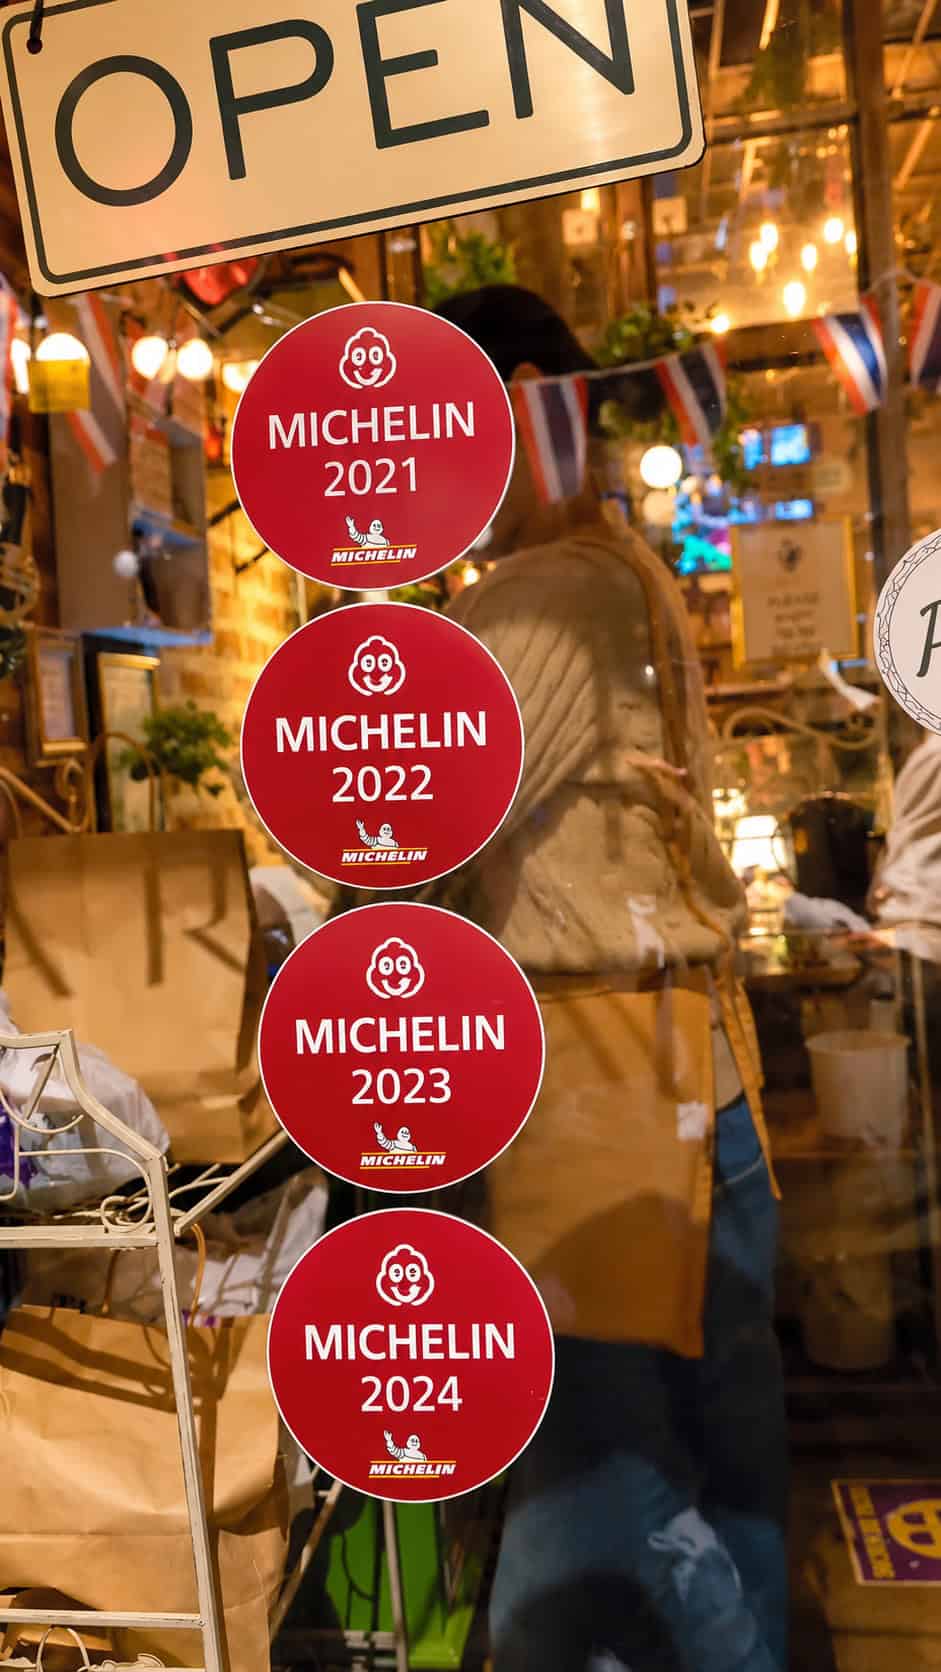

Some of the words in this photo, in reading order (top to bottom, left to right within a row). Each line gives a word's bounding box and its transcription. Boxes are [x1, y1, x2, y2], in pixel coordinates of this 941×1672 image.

[55, 0, 635, 207] OPEN
[268, 401, 475, 449] MICHELIN
[324, 457, 417, 497] 2021
[331, 548, 417, 562] MICHELIN
[275, 711, 487, 753] MICHELIN
[332, 764, 434, 803] 2022
[341, 849, 428, 863] MICHELIN
[295, 1014, 505, 1055] MICHELIN
[351, 1067, 452, 1105] 2023
[360, 1154, 446, 1166] MICHELIN
[304, 1323, 515, 1360] MICHELIN
[361, 1375, 463, 1412] 2024
[369, 1463, 456, 1475] MICHELIN
